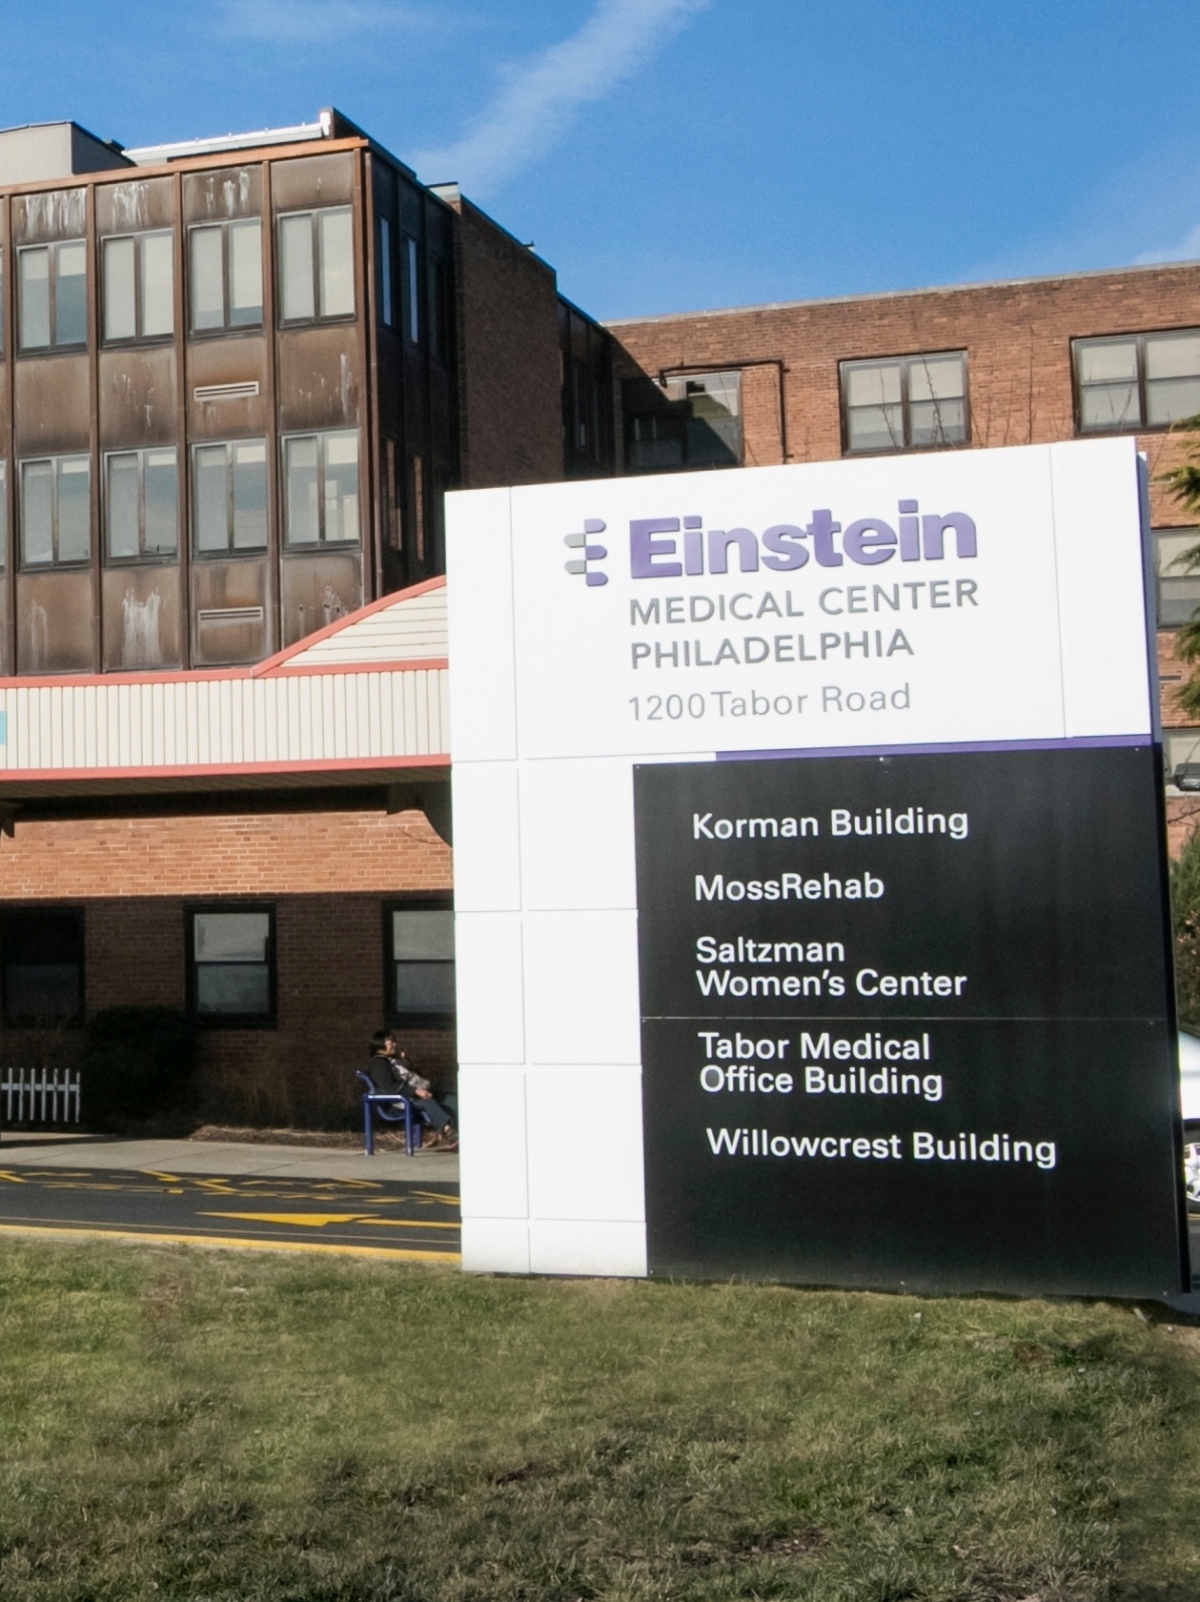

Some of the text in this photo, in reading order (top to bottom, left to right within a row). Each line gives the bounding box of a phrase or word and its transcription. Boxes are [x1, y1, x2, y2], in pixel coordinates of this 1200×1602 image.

[629, 499, 978, 580] Einstein
[629, 578, 979, 626] MEDICAL CENTER
[630, 628, 915, 670] PHILADELPHIA
[628, 682, 911, 721] 1200 Tabor Road
[692, 806, 969, 840] Korman Building
[694, 871, 885, 902] MossRehab
[696, 935, 845, 964] Saltzman
[696, 968, 968, 997] Women's Center
[697, 1031, 930, 1061] Tabor Medical
[699, 1064, 943, 1102] Office Building
[705, 1127, 1057, 1169] Willowcrest Building
